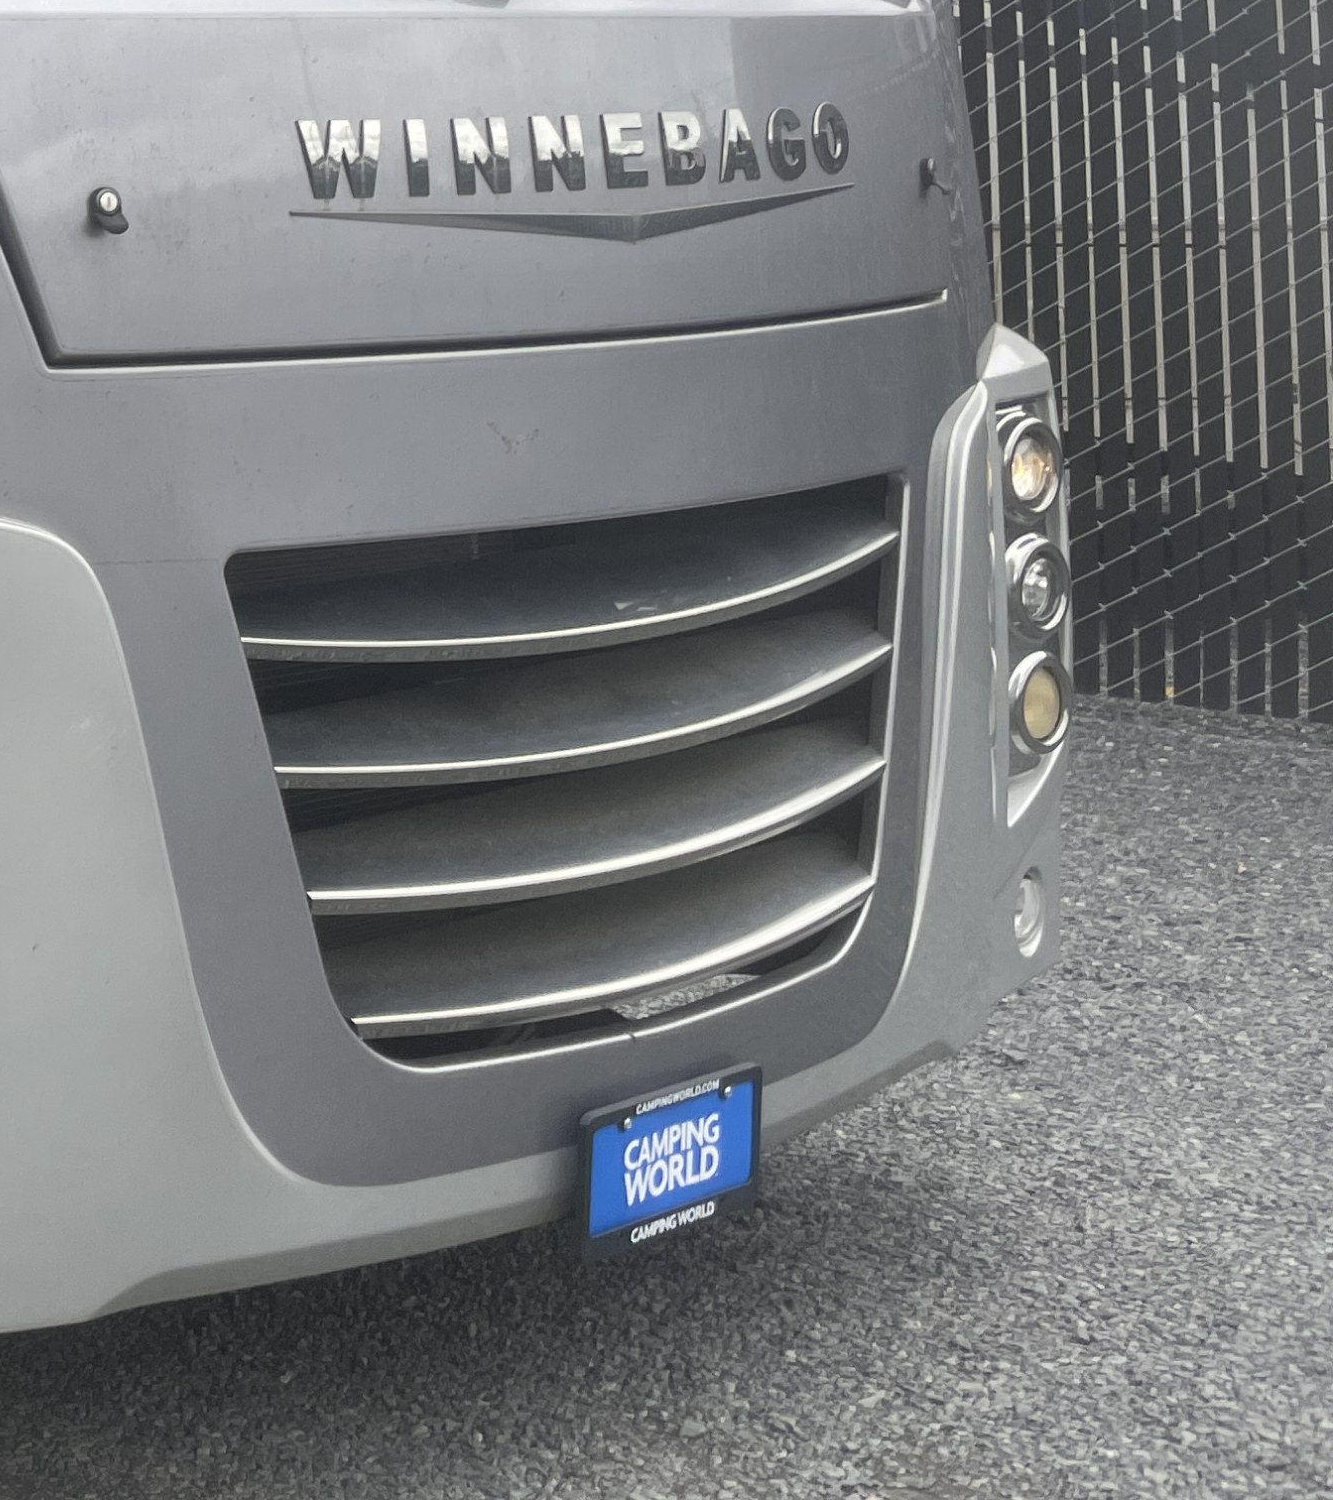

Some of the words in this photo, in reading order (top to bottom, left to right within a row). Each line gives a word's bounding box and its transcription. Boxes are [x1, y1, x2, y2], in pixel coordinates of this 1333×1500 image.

[294, 100, 851, 200] WINNEBAGO
[635, 1078, 720, 1115] CAMPINGWORLD.COM
[624, 1112, 720, 1171] CAMPING
[624, 1145, 720, 1207] WORLD
[630, 1213, 677, 1244] CAMPING
[677, 1200, 715, 1227] WORLD
